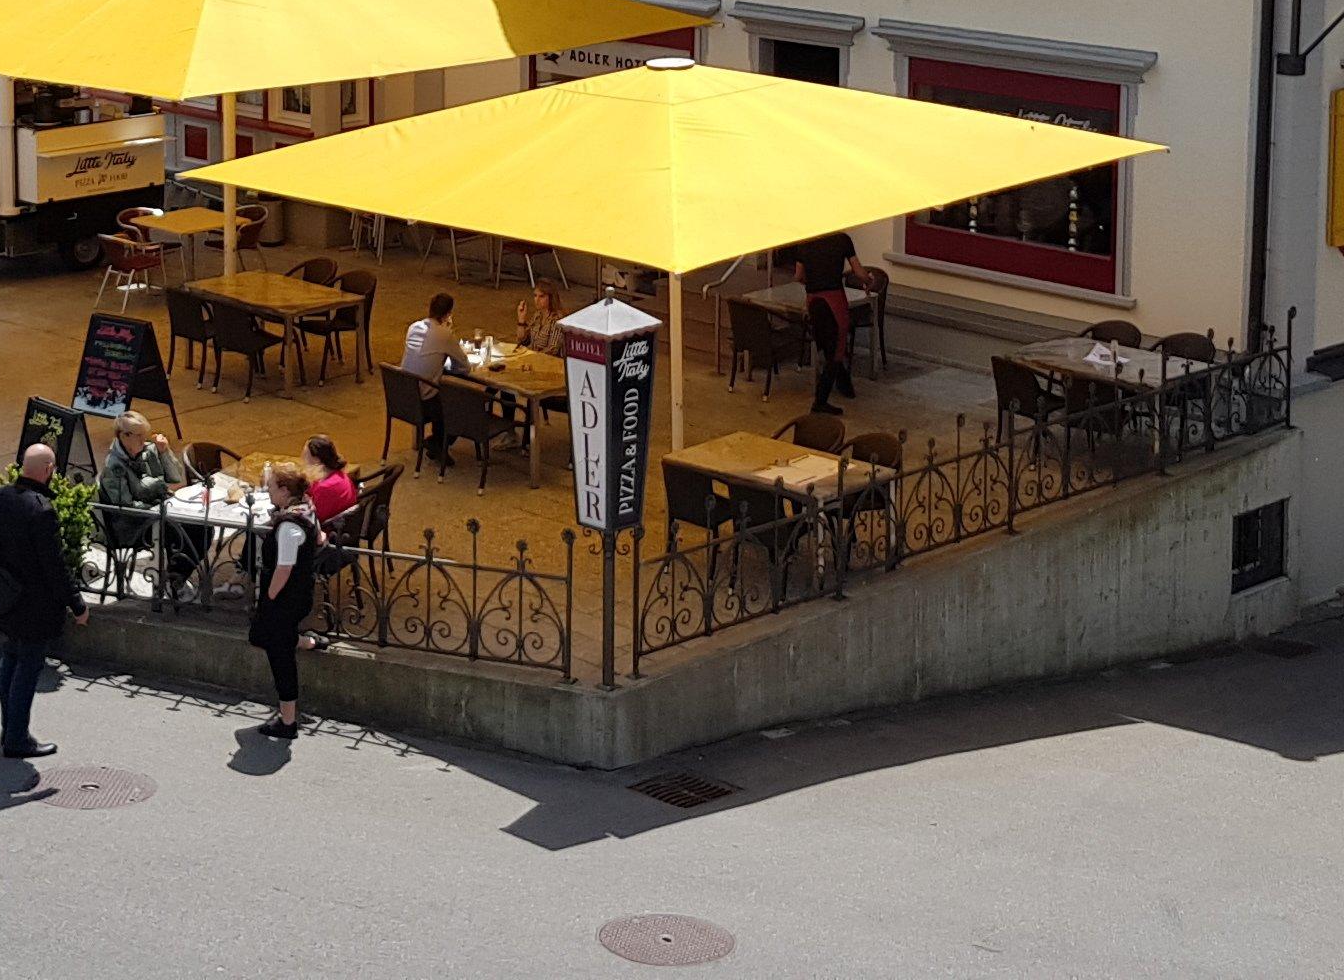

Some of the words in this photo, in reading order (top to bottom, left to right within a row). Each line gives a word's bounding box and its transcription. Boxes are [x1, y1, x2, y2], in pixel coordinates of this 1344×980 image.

[570, 49, 610, 66] ADLER
[570, 338, 603, 357] HOTEL
[612, 339, 650, 368] Little
[617, 359, 650, 383] Italy
[622, 387, 641, 442] FOOD
[580, 369, 602, 521] ADLER
[625, 444, 637, 456] &
[618, 457, 637, 516] PIZZA
